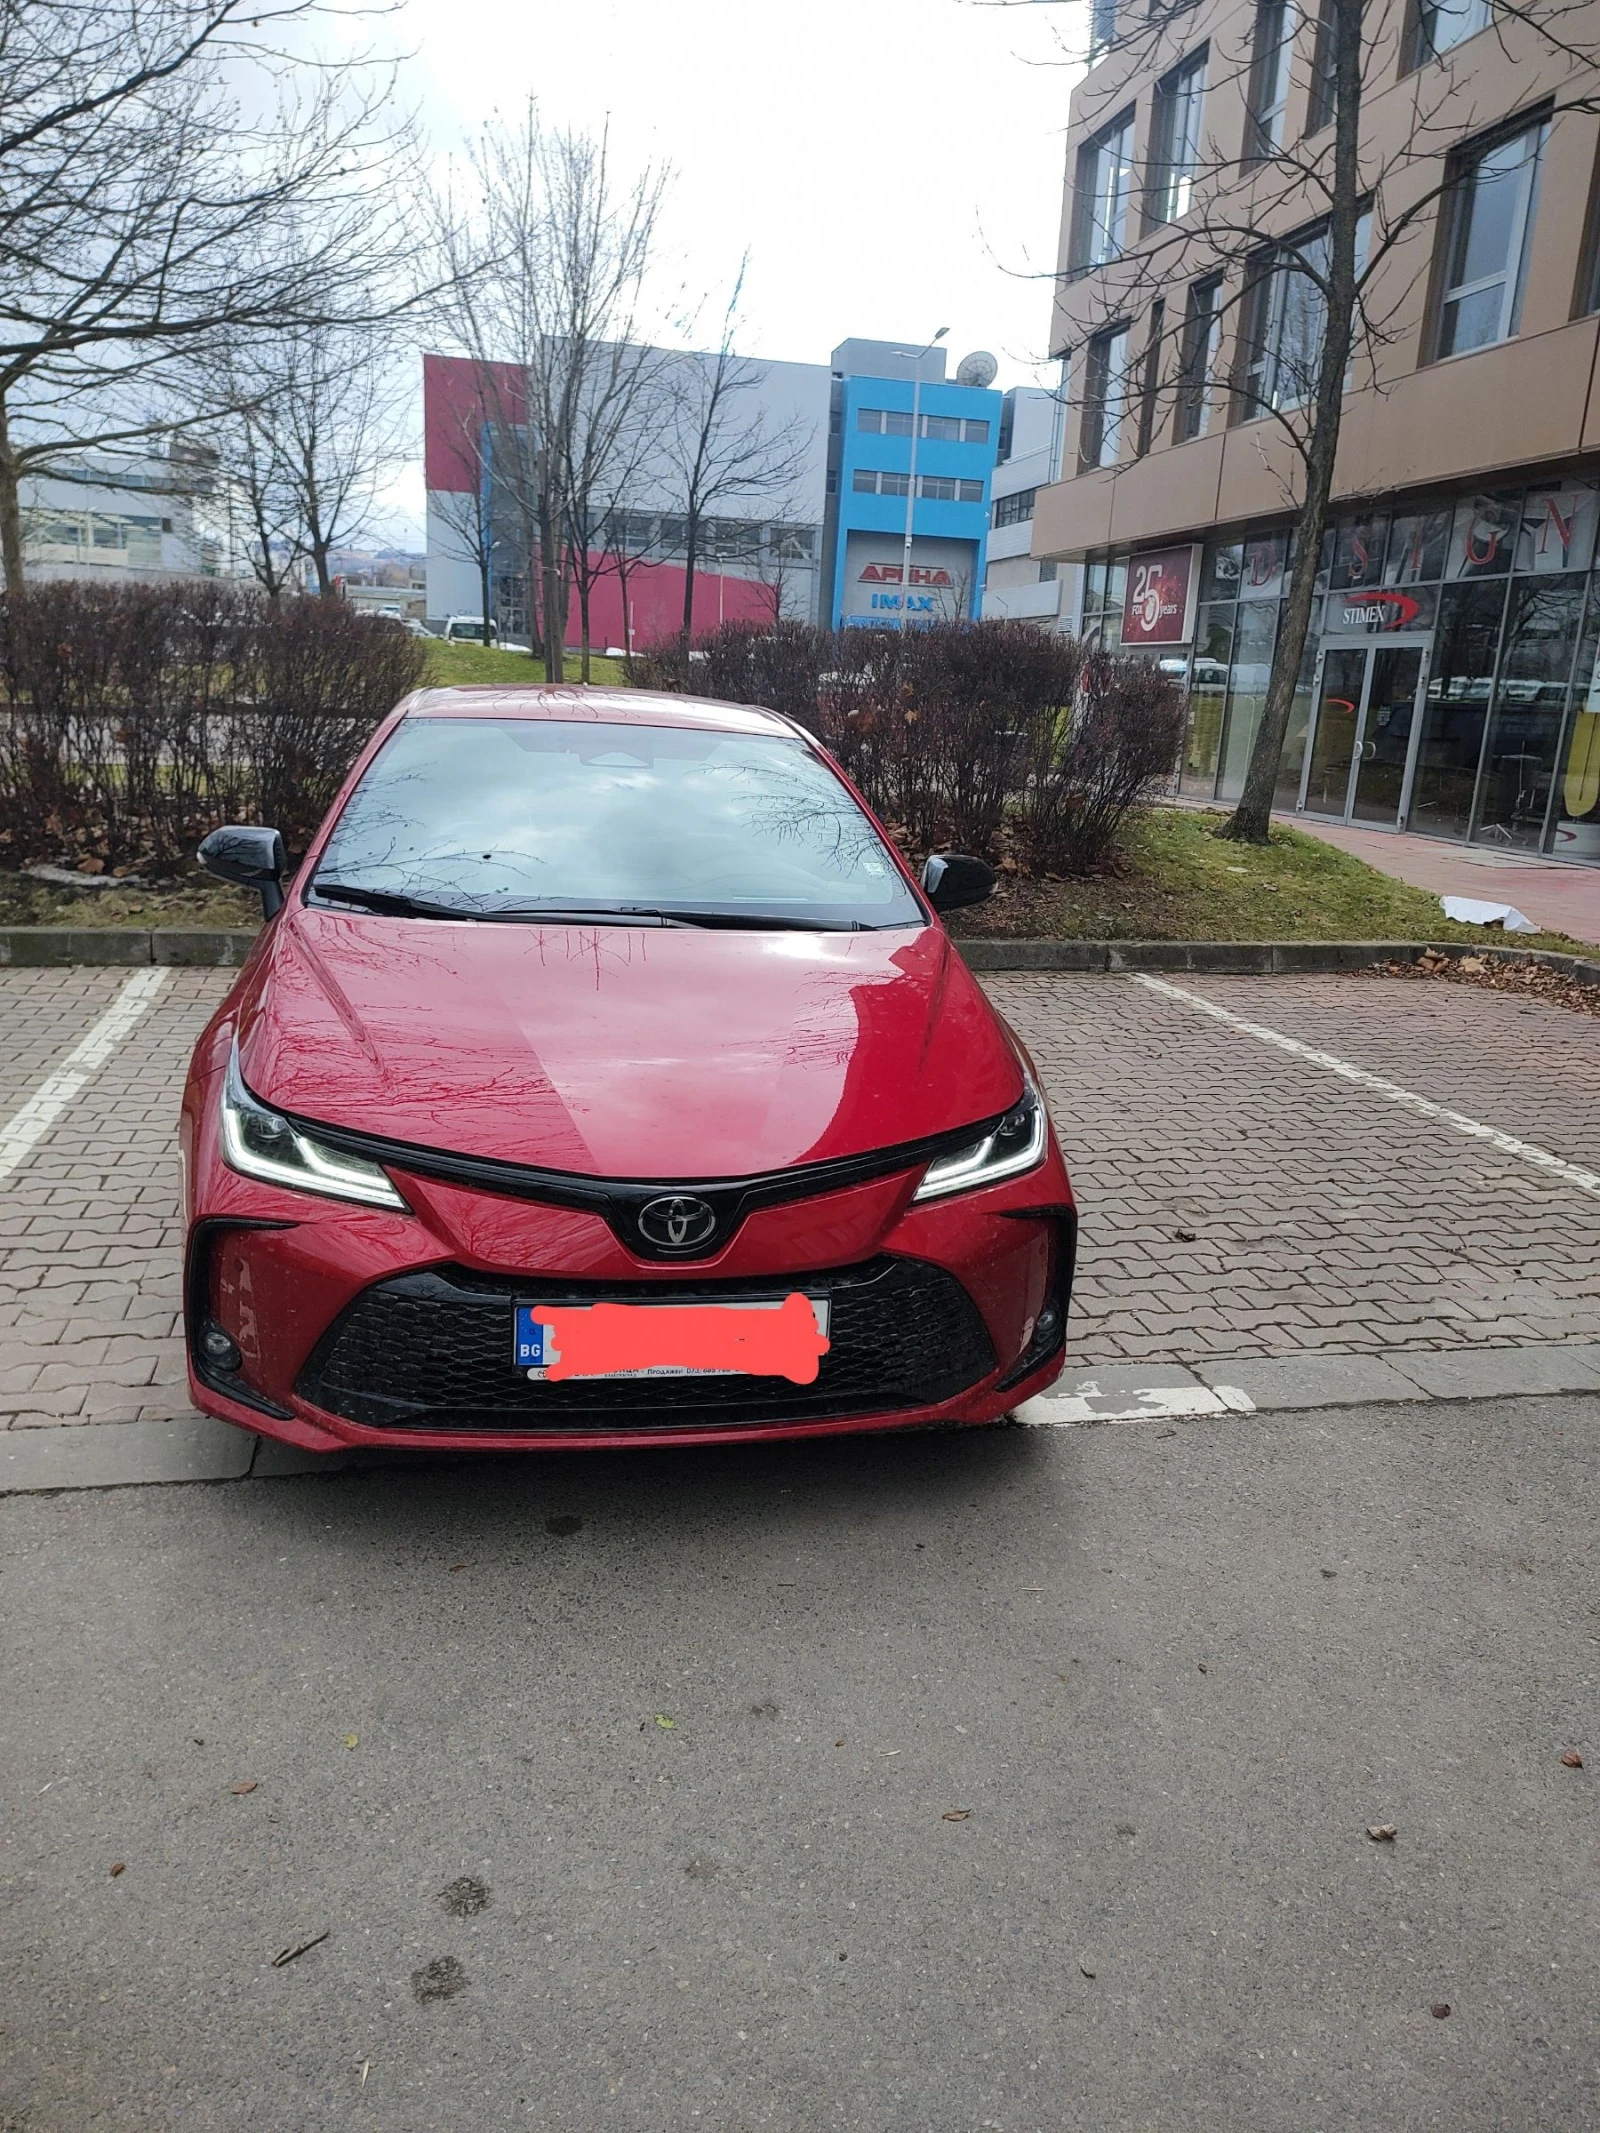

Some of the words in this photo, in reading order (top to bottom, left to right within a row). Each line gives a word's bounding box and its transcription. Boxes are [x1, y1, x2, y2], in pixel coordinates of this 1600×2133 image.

[1247, 494, 1583, 588] DSIGN
[1133, 565, 1163, 631] 25
[1158, 604, 1178, 619] years
[1342, 606, 1386, 625] STIMEX
[520, 1344, 541, 1357] BG
